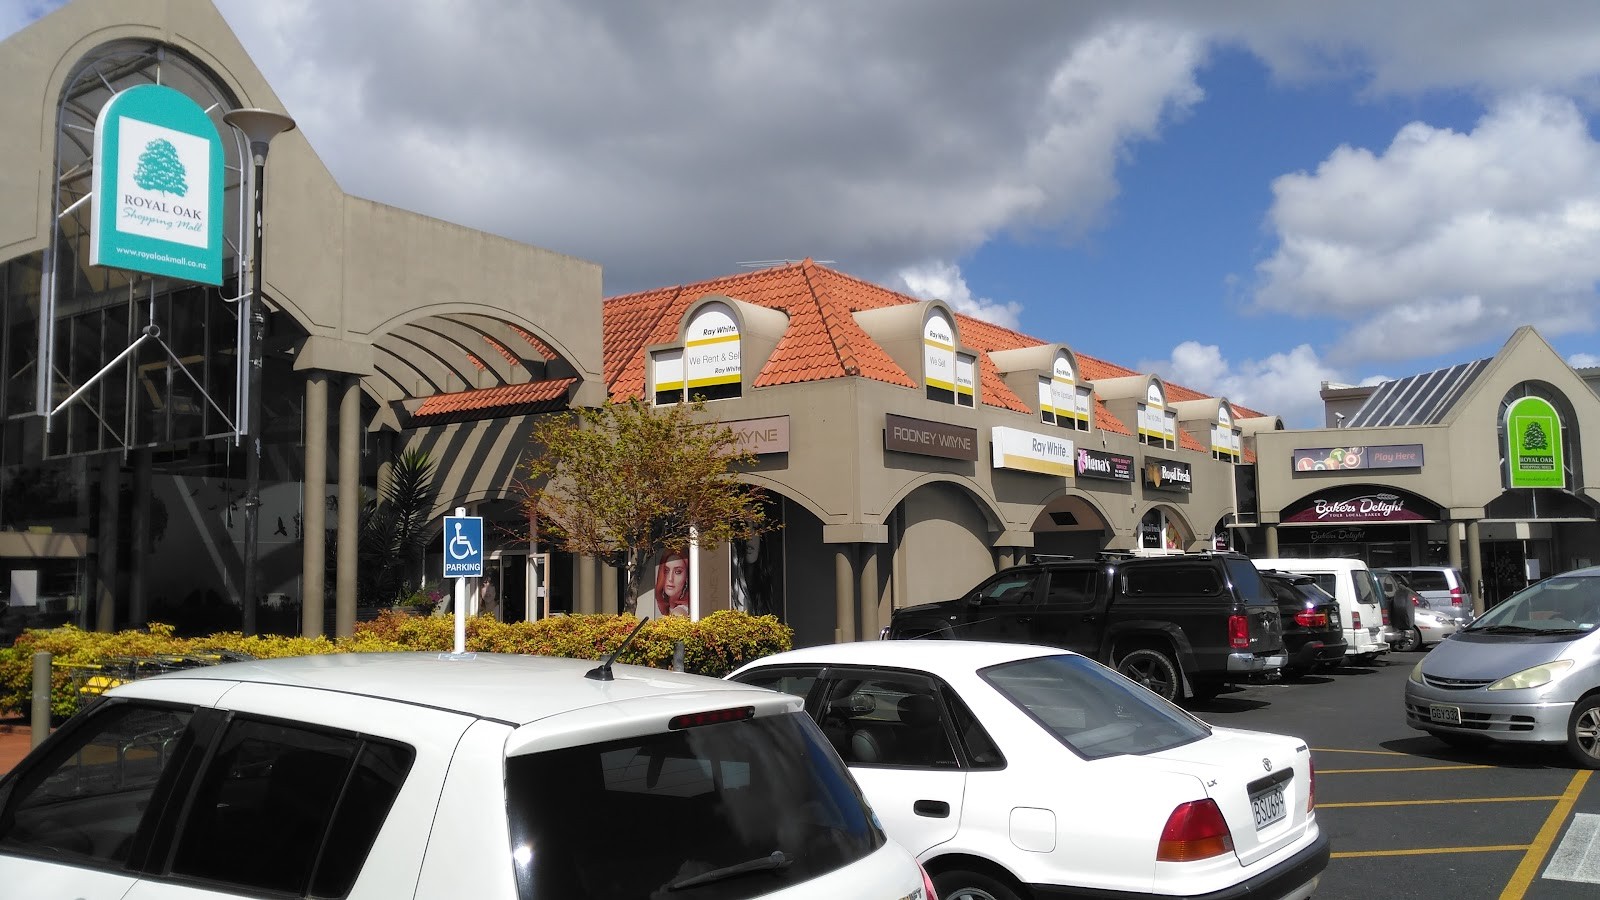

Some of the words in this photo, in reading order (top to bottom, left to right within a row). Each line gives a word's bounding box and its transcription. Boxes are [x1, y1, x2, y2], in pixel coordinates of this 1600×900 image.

[124, 194, 169, 214] ROYAL
[173, 204, 202, 221] OAK
[122, 206, 173, 231] Shopping
[177, 219, 203, 233] Mall
[116, 247, 207, 270] www.royaloakmall.co.nz
[703, 327, 716, 337] Ray
[716, 324, 736, 334] White
[930, 330, 939, 340] Ray
[689, 356, 700, 366] We
[702, 353, 719, 364] Rent
[721, 353, 727, 361] &
[929, 356, 938, 366] We
[937, 358, 946, 368] Sell
[714, 366, 725, 375] Ray
[725, 365, 741, 373] White
[737, 428, 778, 446] AYNE
[893, 426, 938, 446] RODNEY
[938, 432, 971, 451] WAYNE
[1032, 437, 1047, 454] Ray
[1047, 440, 1067, 458] White
[1374, 452, 1394, 463] Play
[1395, 451, 1416, 461] Here
[1161, 465, 1177, 483] Royal
[1176, 468, 1191, 483] Fresh
[1314, 500, 1356, 519] Bakers
[1360, 498, 1404, 517] Delight
[446, 563, 480, 572] PARKING
[1207, 779, 1217, 788] LX
